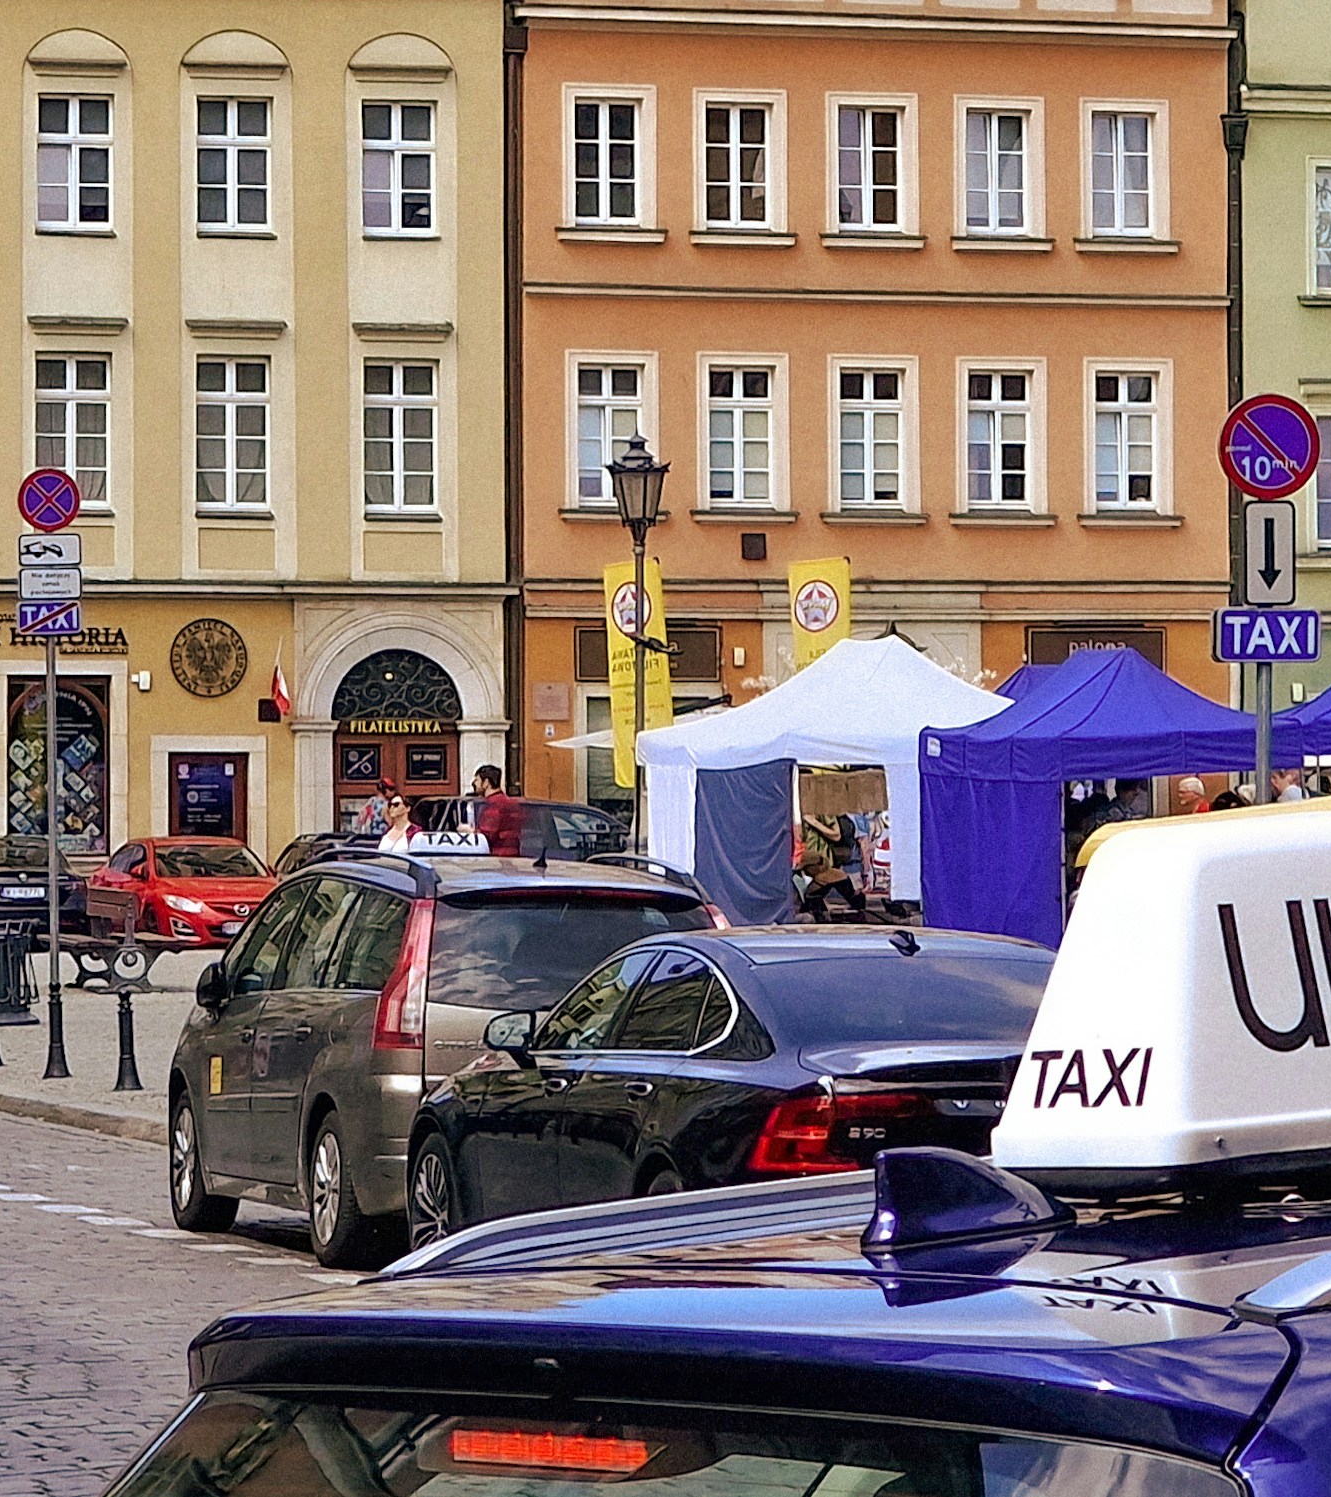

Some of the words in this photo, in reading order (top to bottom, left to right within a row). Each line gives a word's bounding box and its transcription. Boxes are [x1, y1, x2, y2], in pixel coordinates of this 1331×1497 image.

[1241, 455, 1272, 481] 10
[21, 605, 78, 630] TAXI
[1225, 615, 1316, 655] TAXI
[350, 720, 442, 734] FILATELISTYKA
[423, 833, 480, 847] TAXI
[1030, 1047, 1153, 1109] TAXI
